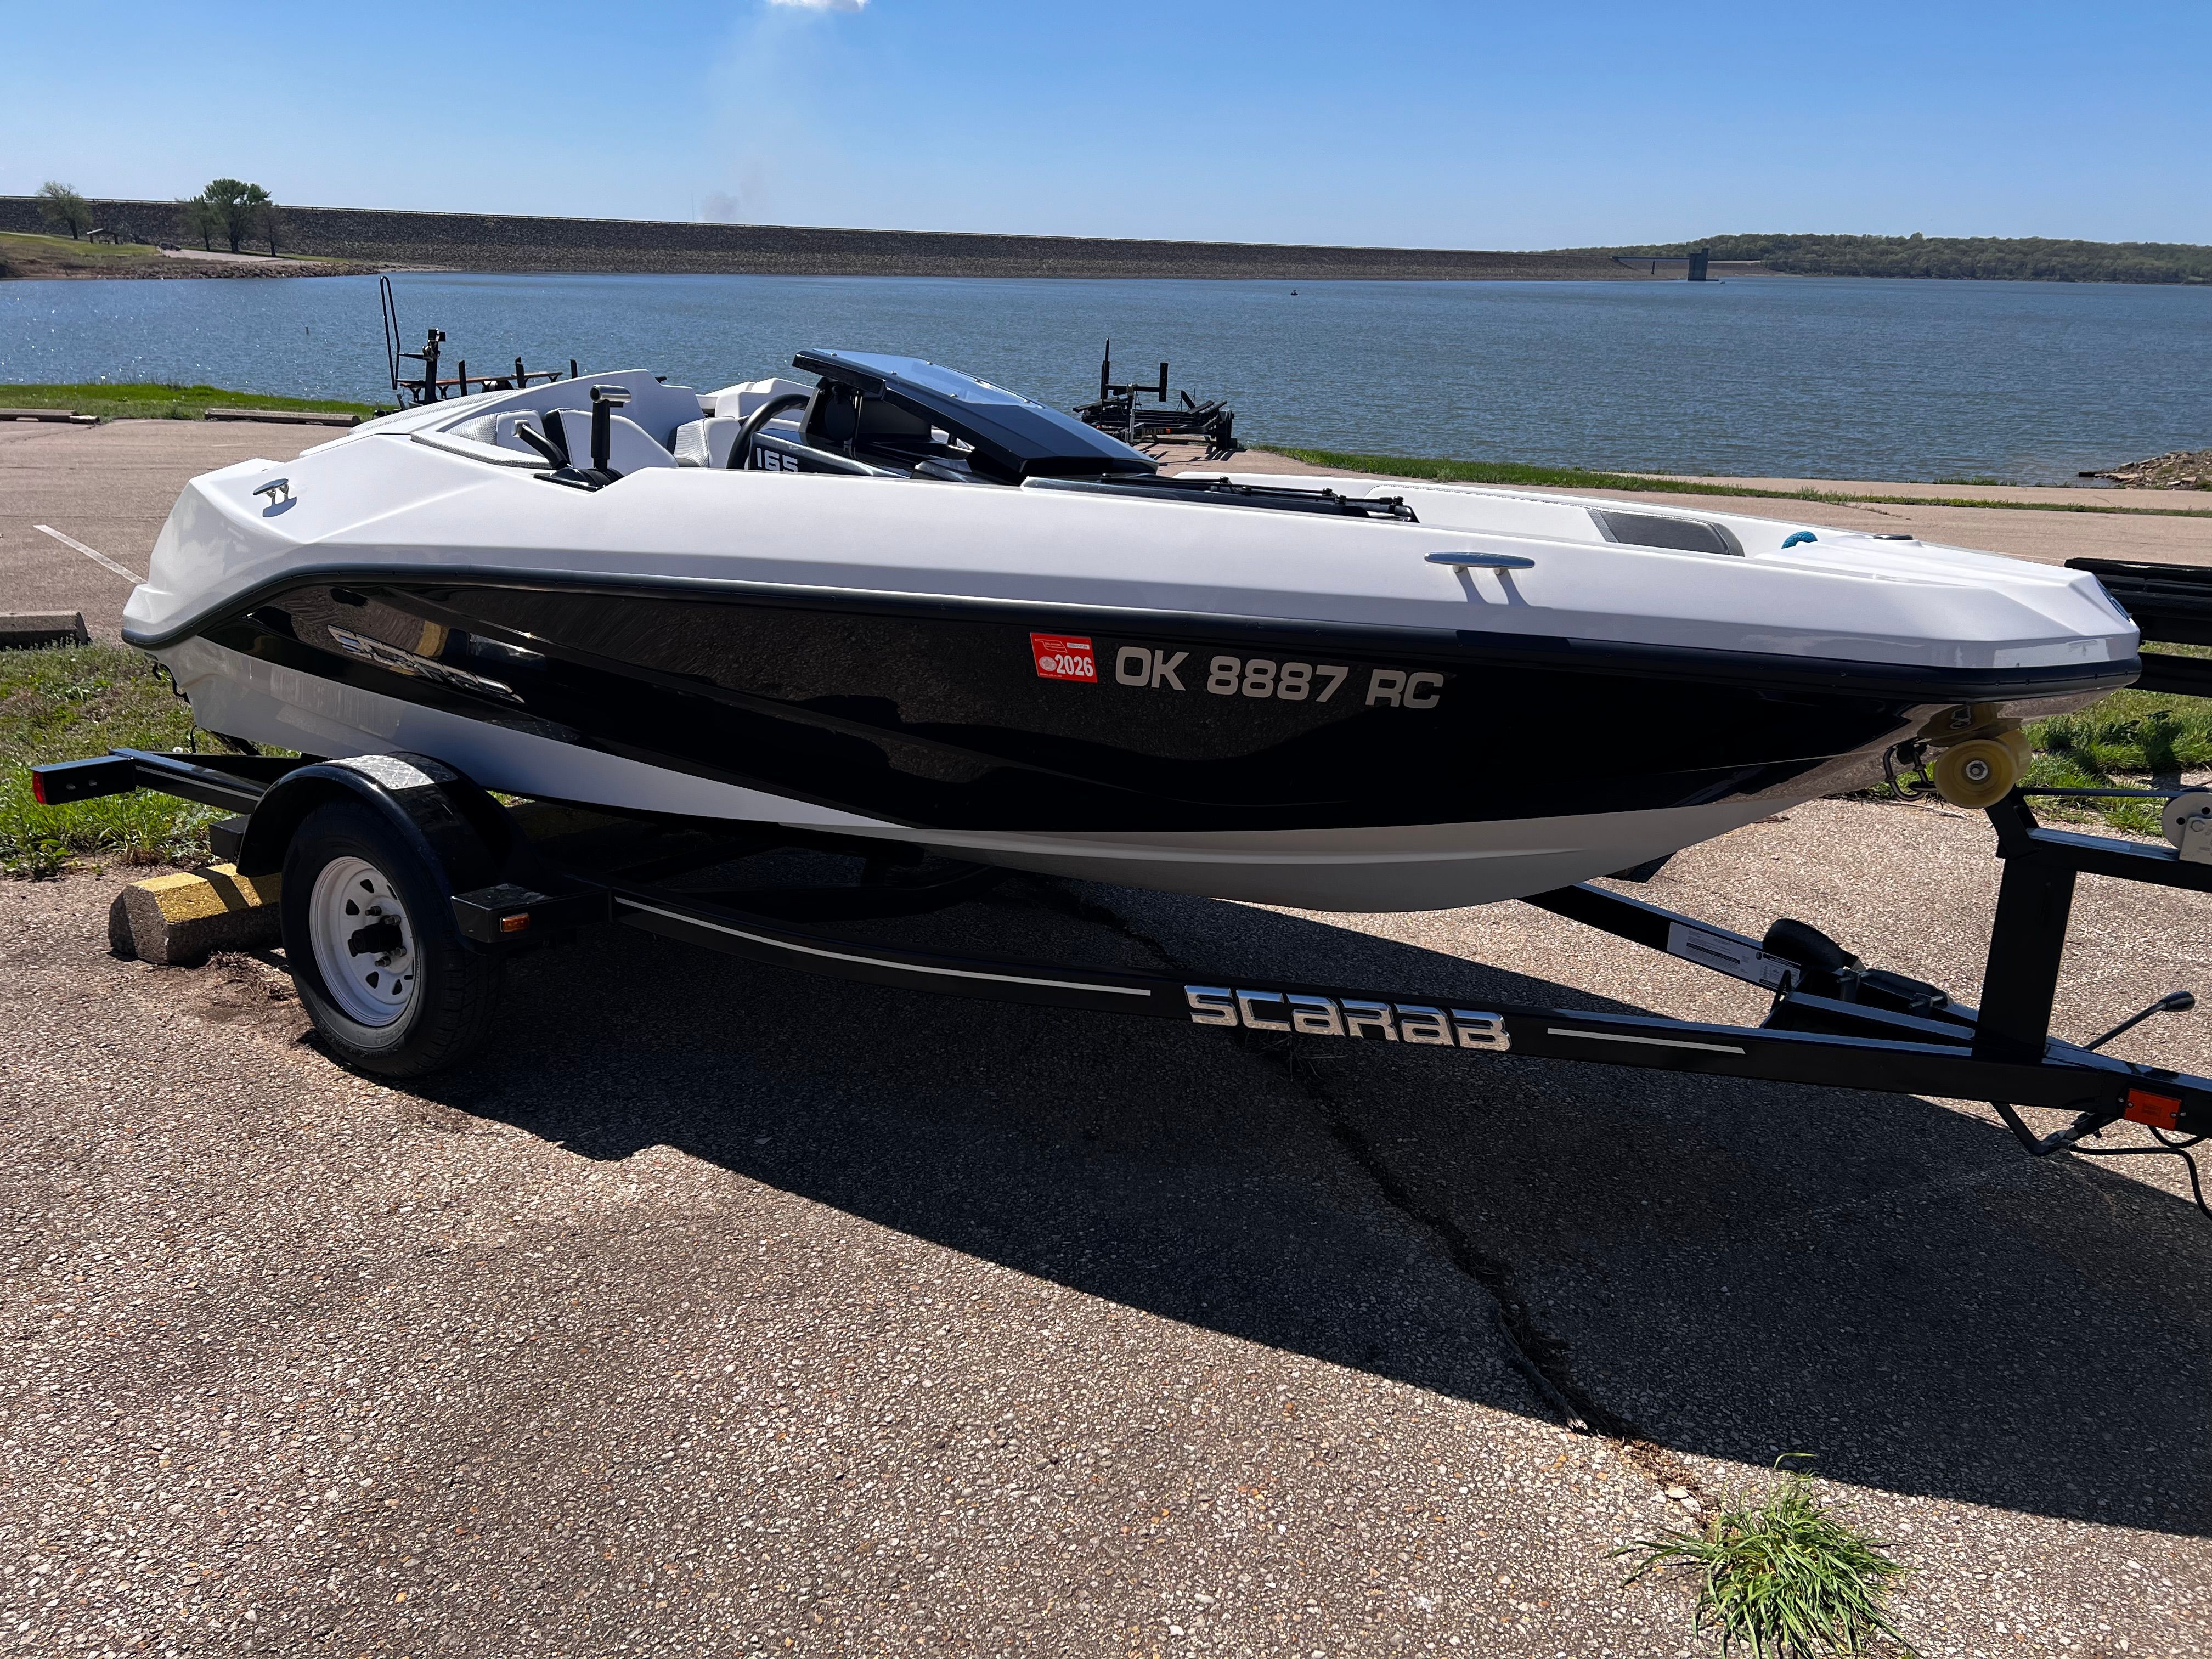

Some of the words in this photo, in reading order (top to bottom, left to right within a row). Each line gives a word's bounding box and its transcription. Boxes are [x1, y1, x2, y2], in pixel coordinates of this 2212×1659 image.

[757, 448, 798, 474] 165
[1055, 654, 1093, 676] 2026
[1116, 647, 1189, 691] OK
[1207, 656, 1349, 703] 8887
[1365, 669, 1444, 709] RC
